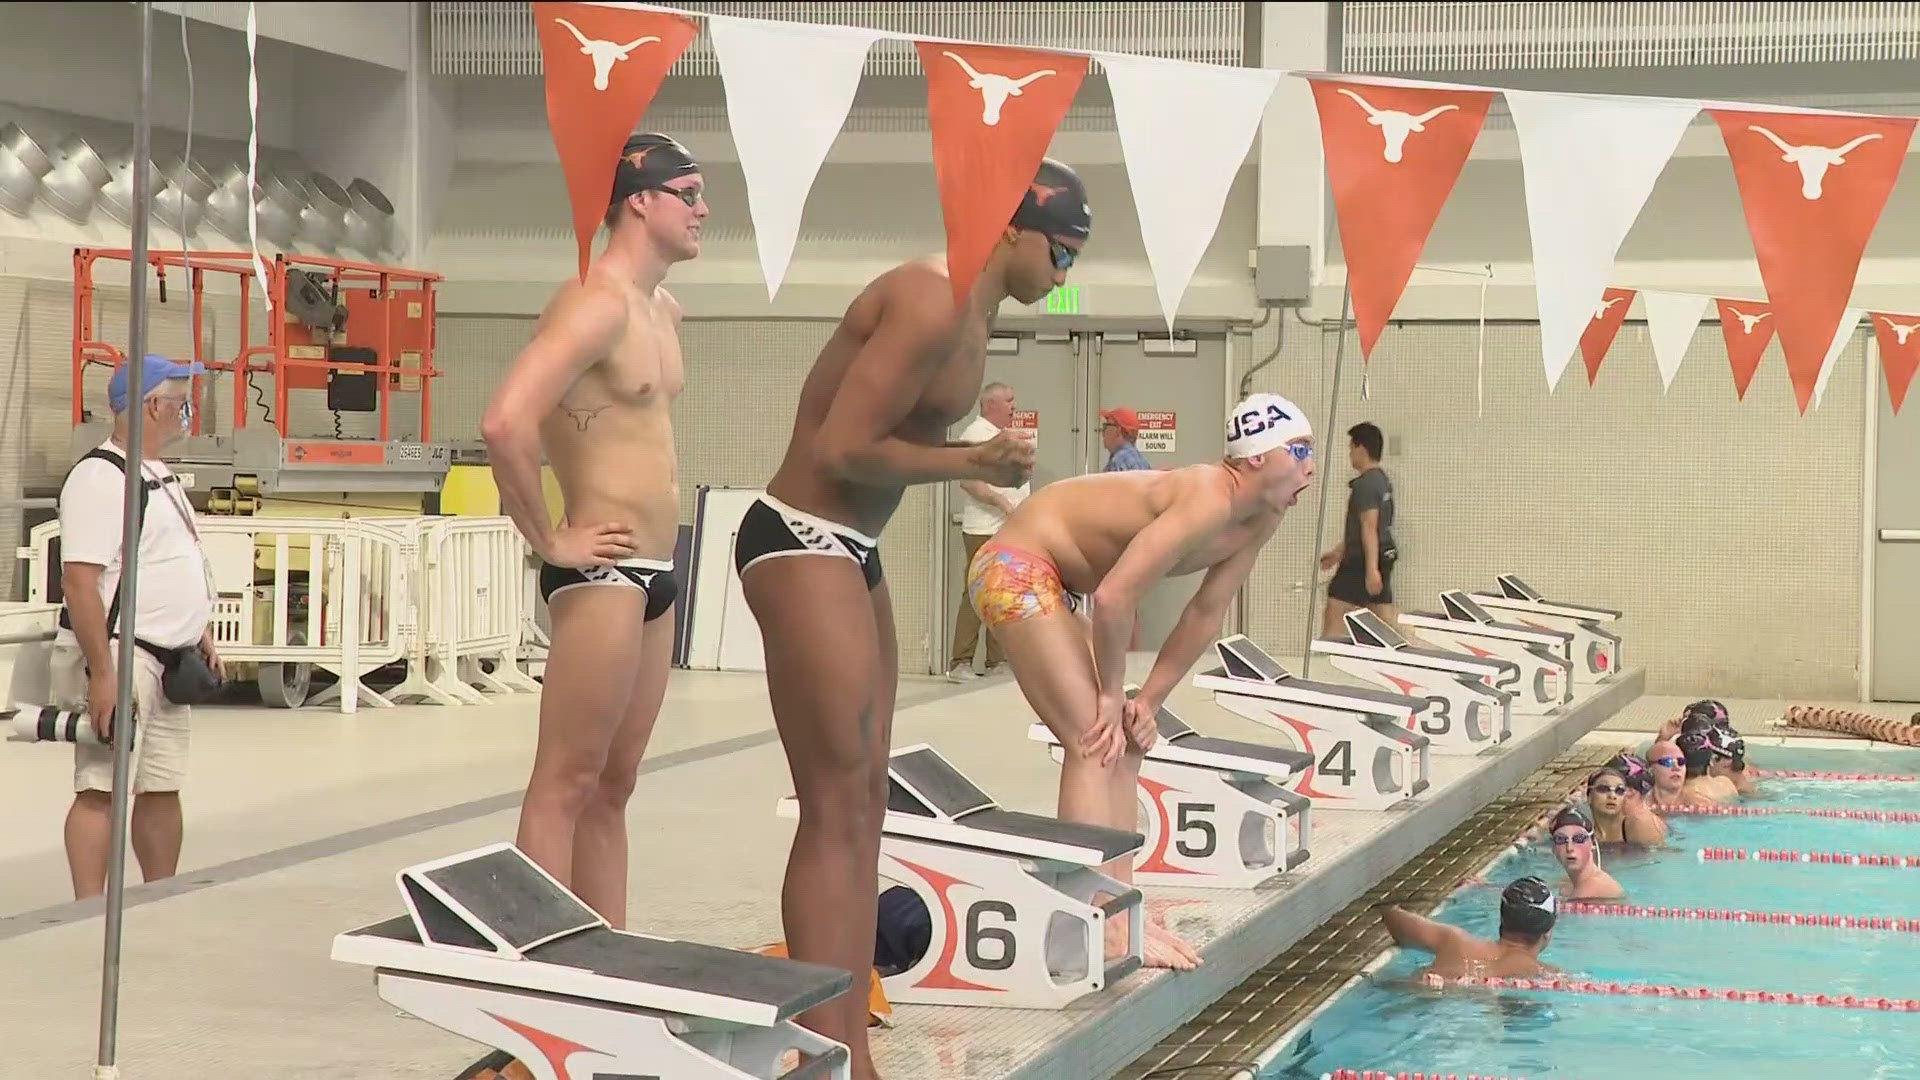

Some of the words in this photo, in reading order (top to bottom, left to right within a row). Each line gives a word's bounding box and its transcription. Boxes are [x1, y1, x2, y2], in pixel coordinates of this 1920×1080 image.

[1047, 287, 1080, 314] EXIT
[1137, 413, 1174, 421] EMERGENCY
[1149, 421, 1162, 429] EXIT
[1226, 404, 1292, 442] USA
[1145, 442, 1167, 450] SOUND
[1496, 663, 1520, 696] 2
[1420, 695, 1451, 735] 3
[1318, 740, 1356, 786] 4
[1175, 802, 1217, 858] 5
[965, 900, 1017, 970] 6
